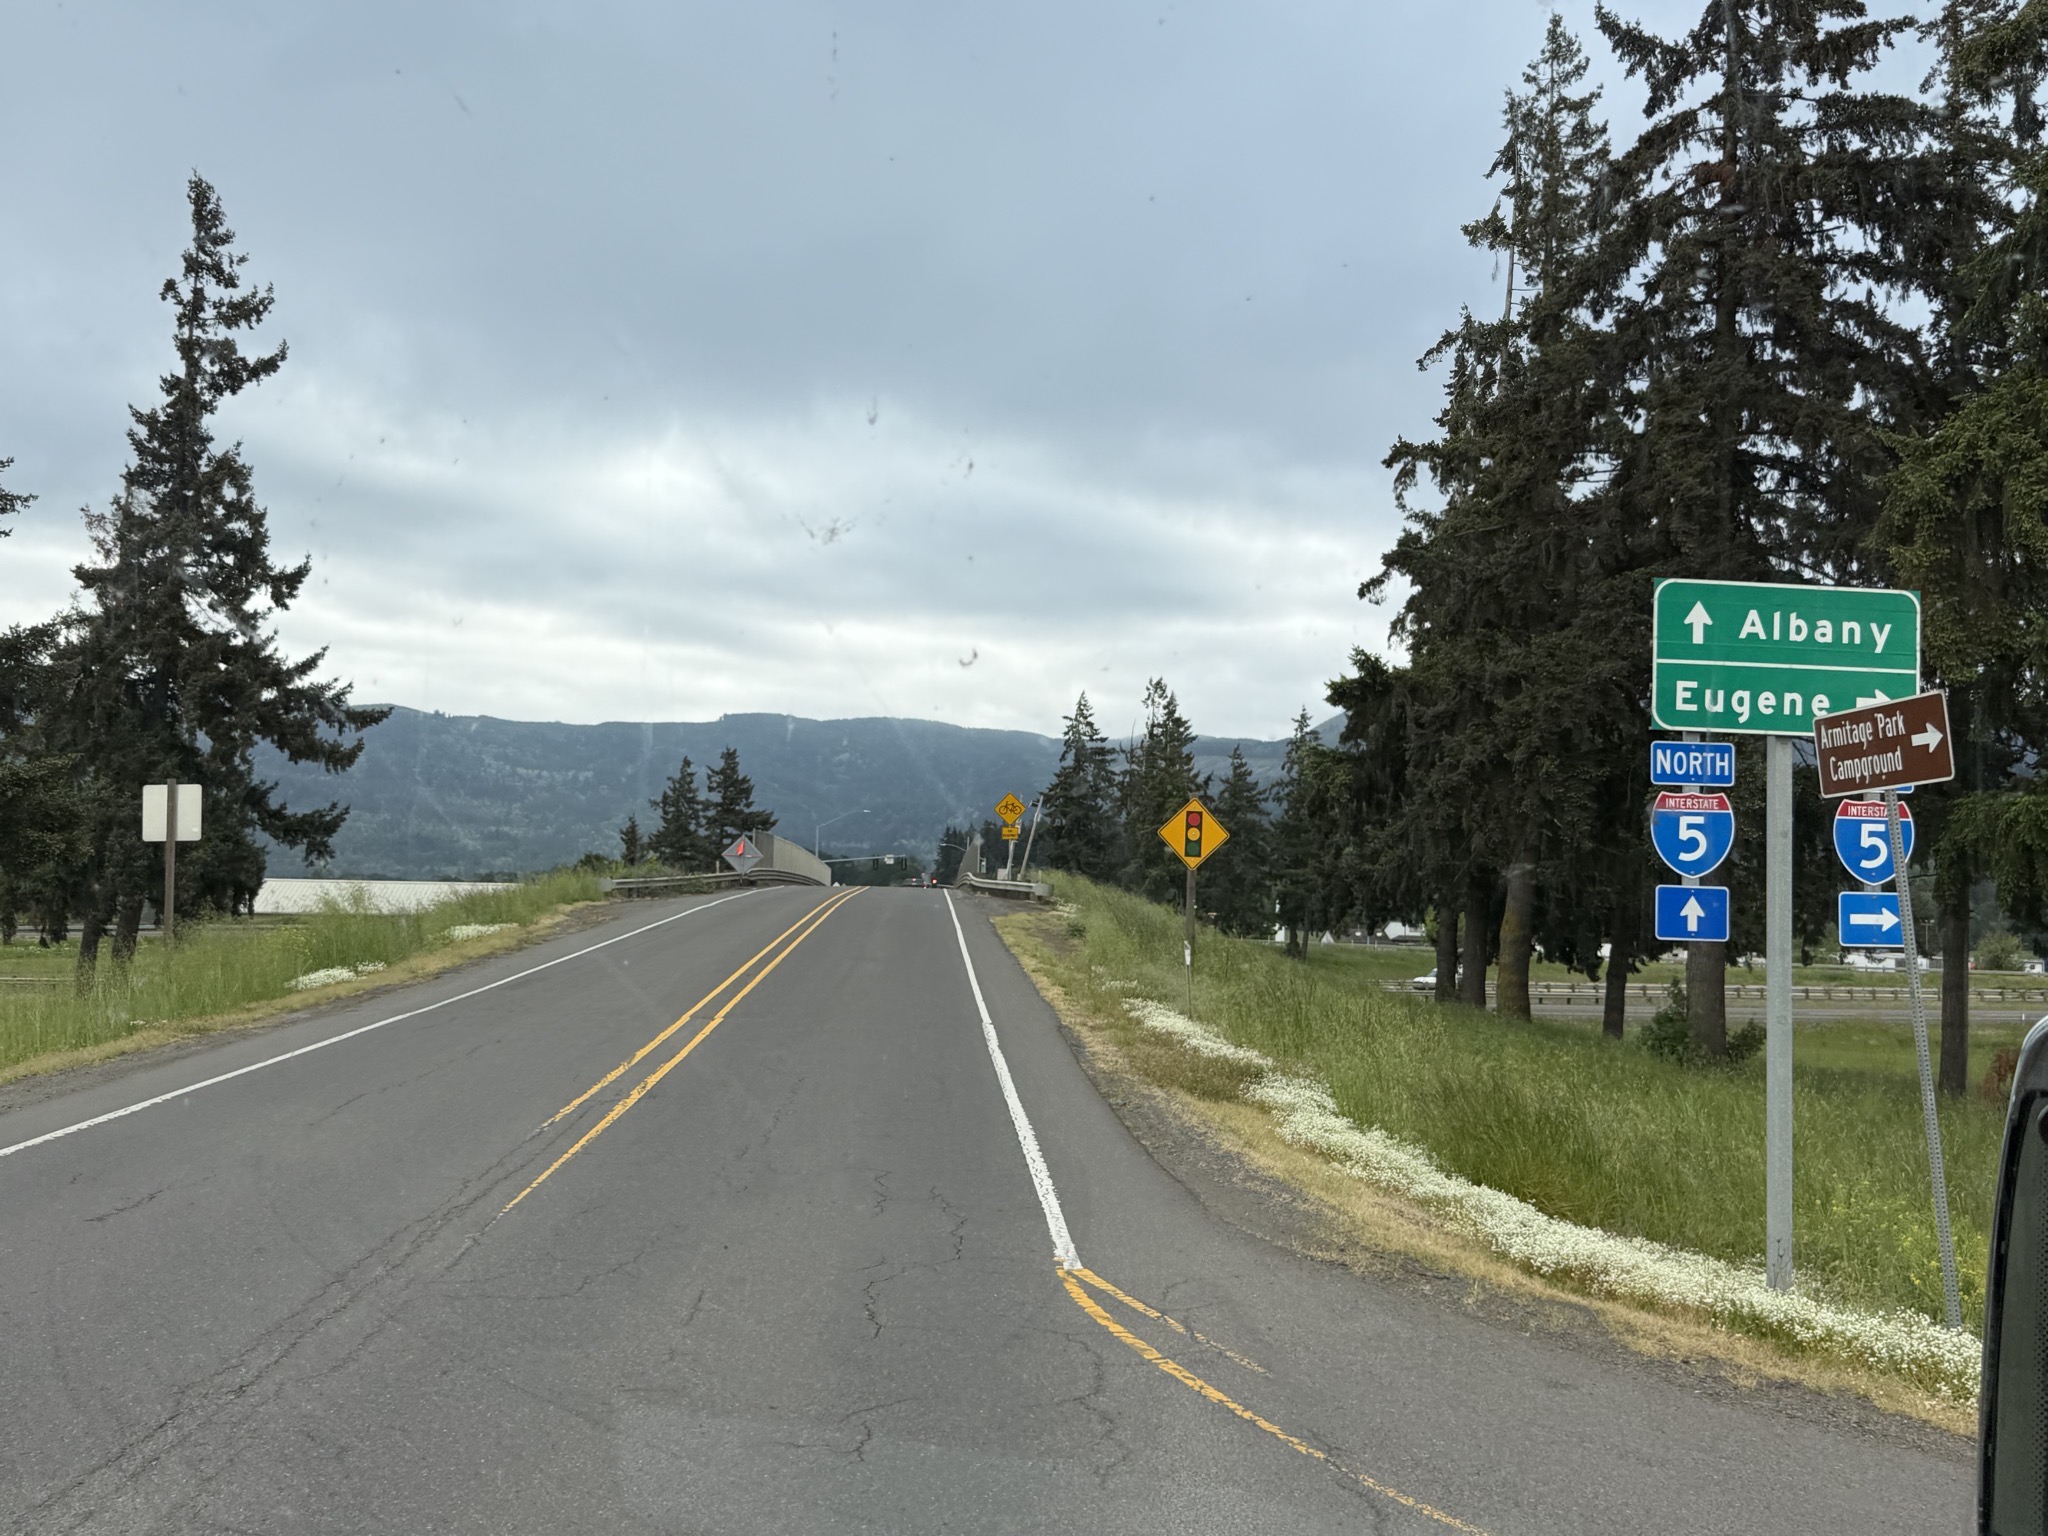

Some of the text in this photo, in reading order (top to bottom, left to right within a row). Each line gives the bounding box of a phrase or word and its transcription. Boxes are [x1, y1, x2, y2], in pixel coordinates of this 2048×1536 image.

[1739, 609, 1892, 653] Albany
[1675, 680, 1831, 723] Eugene
[1820, 710, 1906, 751] Armitage Park
[1656, 749, 1729, 776] NORTH
[1829, 747, 1903, 784] Campground
[1665, 797, 1720, 810] INTERSTATE
[1847, 805, 1889, 817] INTERSTA
[1678, 815, 1708, 862] 5
[1859, 823, 1888, 869] 5
